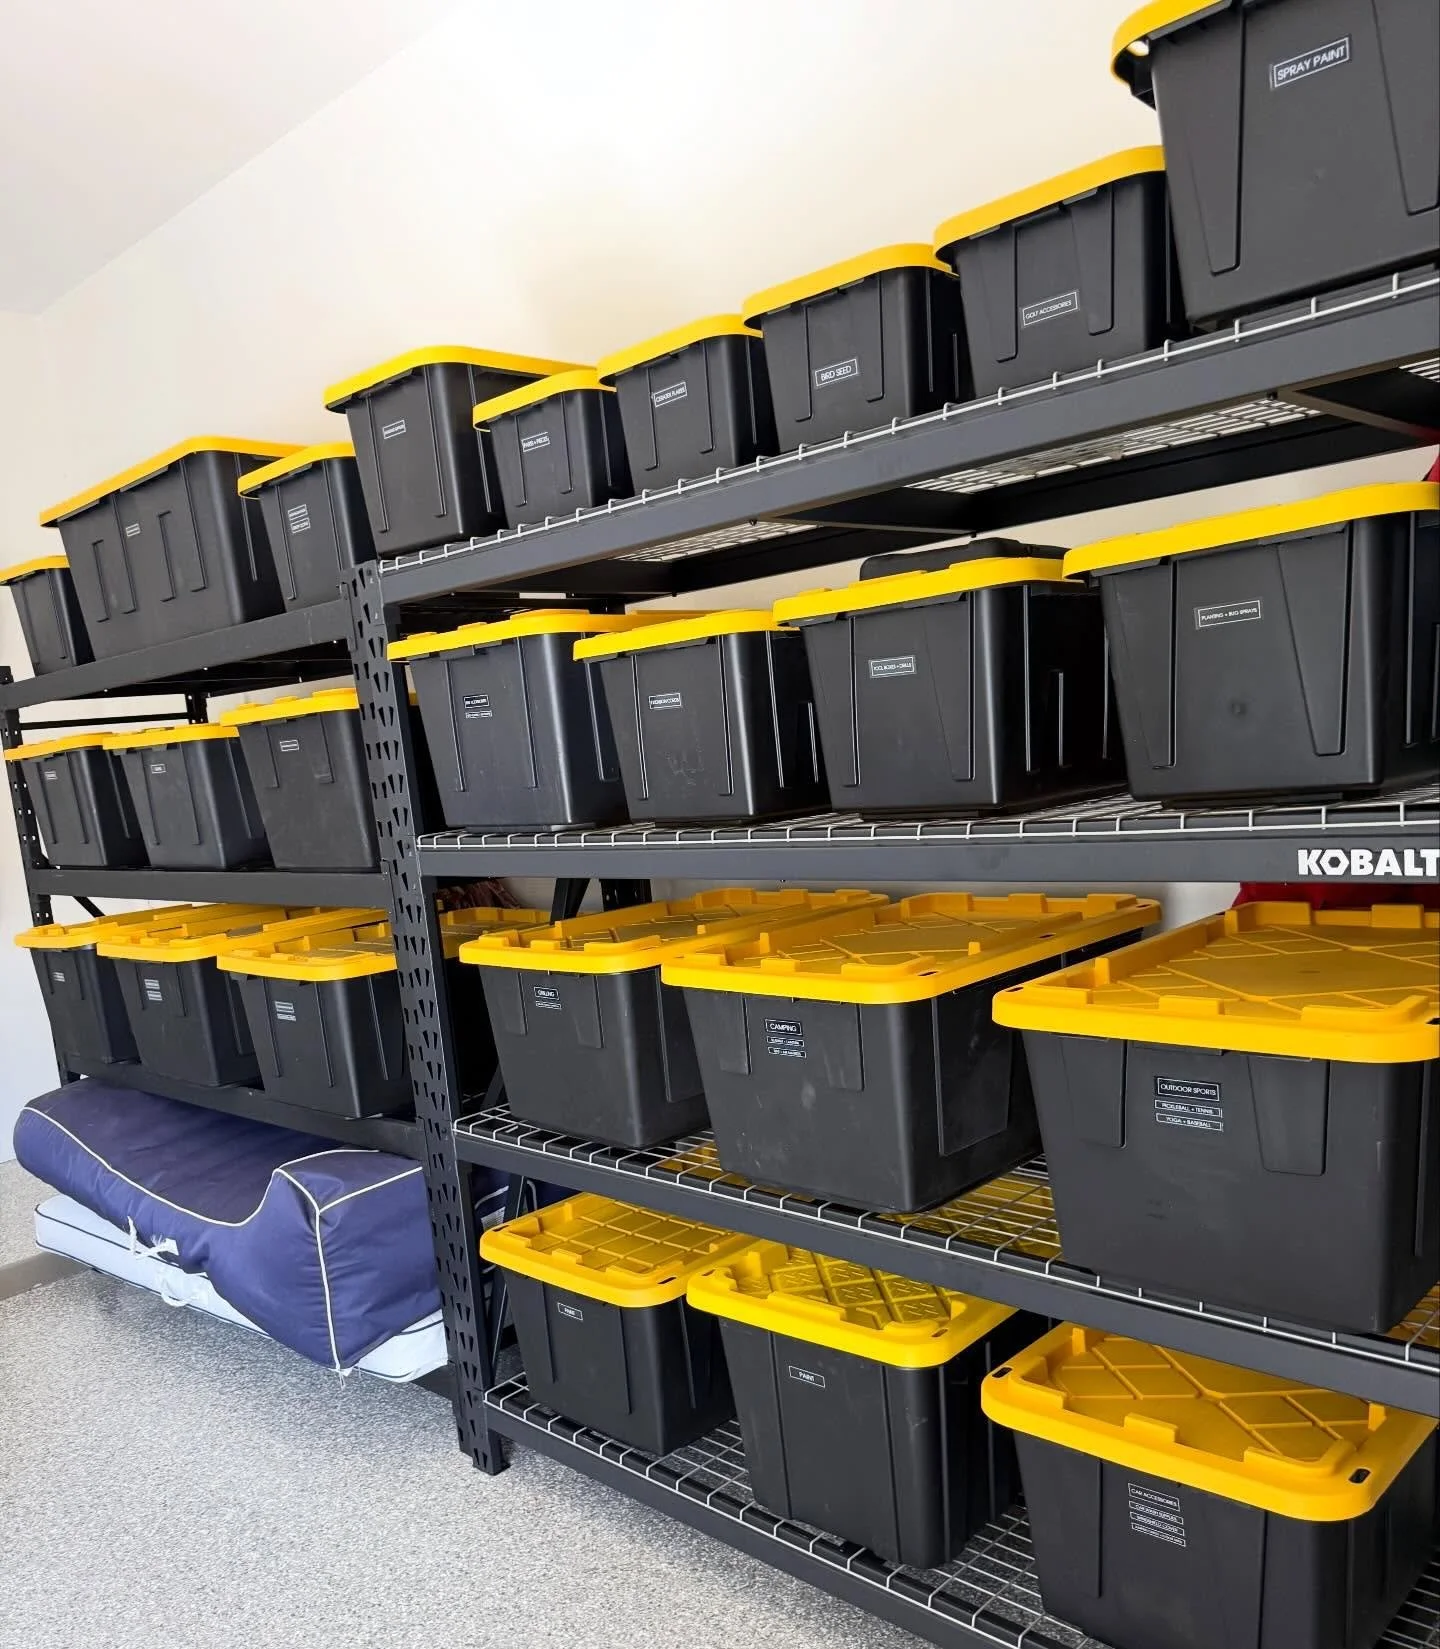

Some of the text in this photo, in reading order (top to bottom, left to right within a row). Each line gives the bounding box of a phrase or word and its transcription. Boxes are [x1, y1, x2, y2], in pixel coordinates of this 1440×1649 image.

[1277, 45, 1345, 81] SPRAY PAINT
[1039, 300, 1072, 315] ACCESSORIES
[820, 365, 852, 382] BIRD SEED
[1201, 612, 1224, 621] PLANTING
[1239, 607, 1258, 616] SPRAYS
[1297, 848, 1440, 877] KOBALT
[769, 1023, 797, 1032] CAMPING
[1160, 1083, 1217, 1096] OUTDOOR SPORTS
[1161, 1103, 1190, 1112] PICKLEBALL
[1195, 1107, 1214, 1115] TENNIS
[1165, 1116, 1182, 1124] YOGA
[1187, 1119, 1212, 1128] BASEBALL
[798, 1371, 815, 1382] PAINT
[1131, 1488, 1178, 1507] CAR ACCESSORIES
